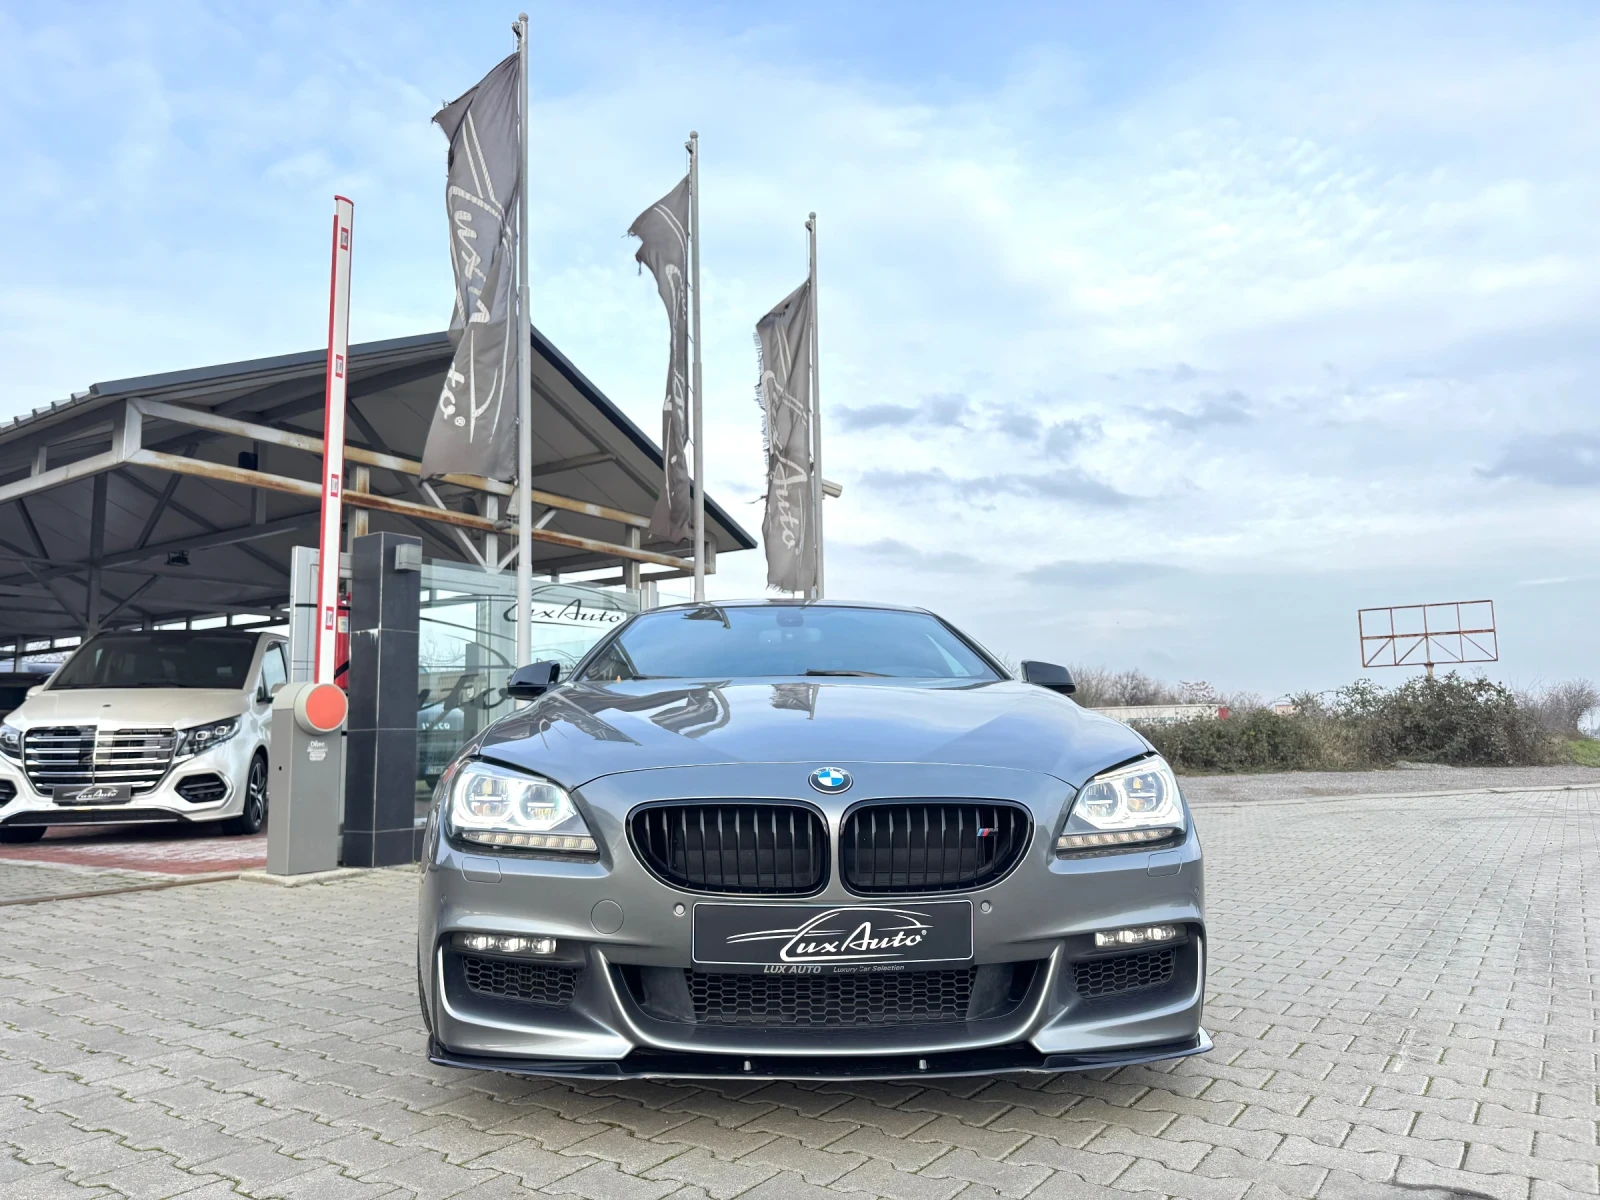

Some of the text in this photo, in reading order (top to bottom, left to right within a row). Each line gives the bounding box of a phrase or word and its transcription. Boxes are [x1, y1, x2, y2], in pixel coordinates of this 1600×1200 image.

[773, 450, 808, 549] Auto
[557, 598, 621, 623] Auto
[840, 921, 923, 953] Auto
[763, 965, 822, 974] LUX AUTO
